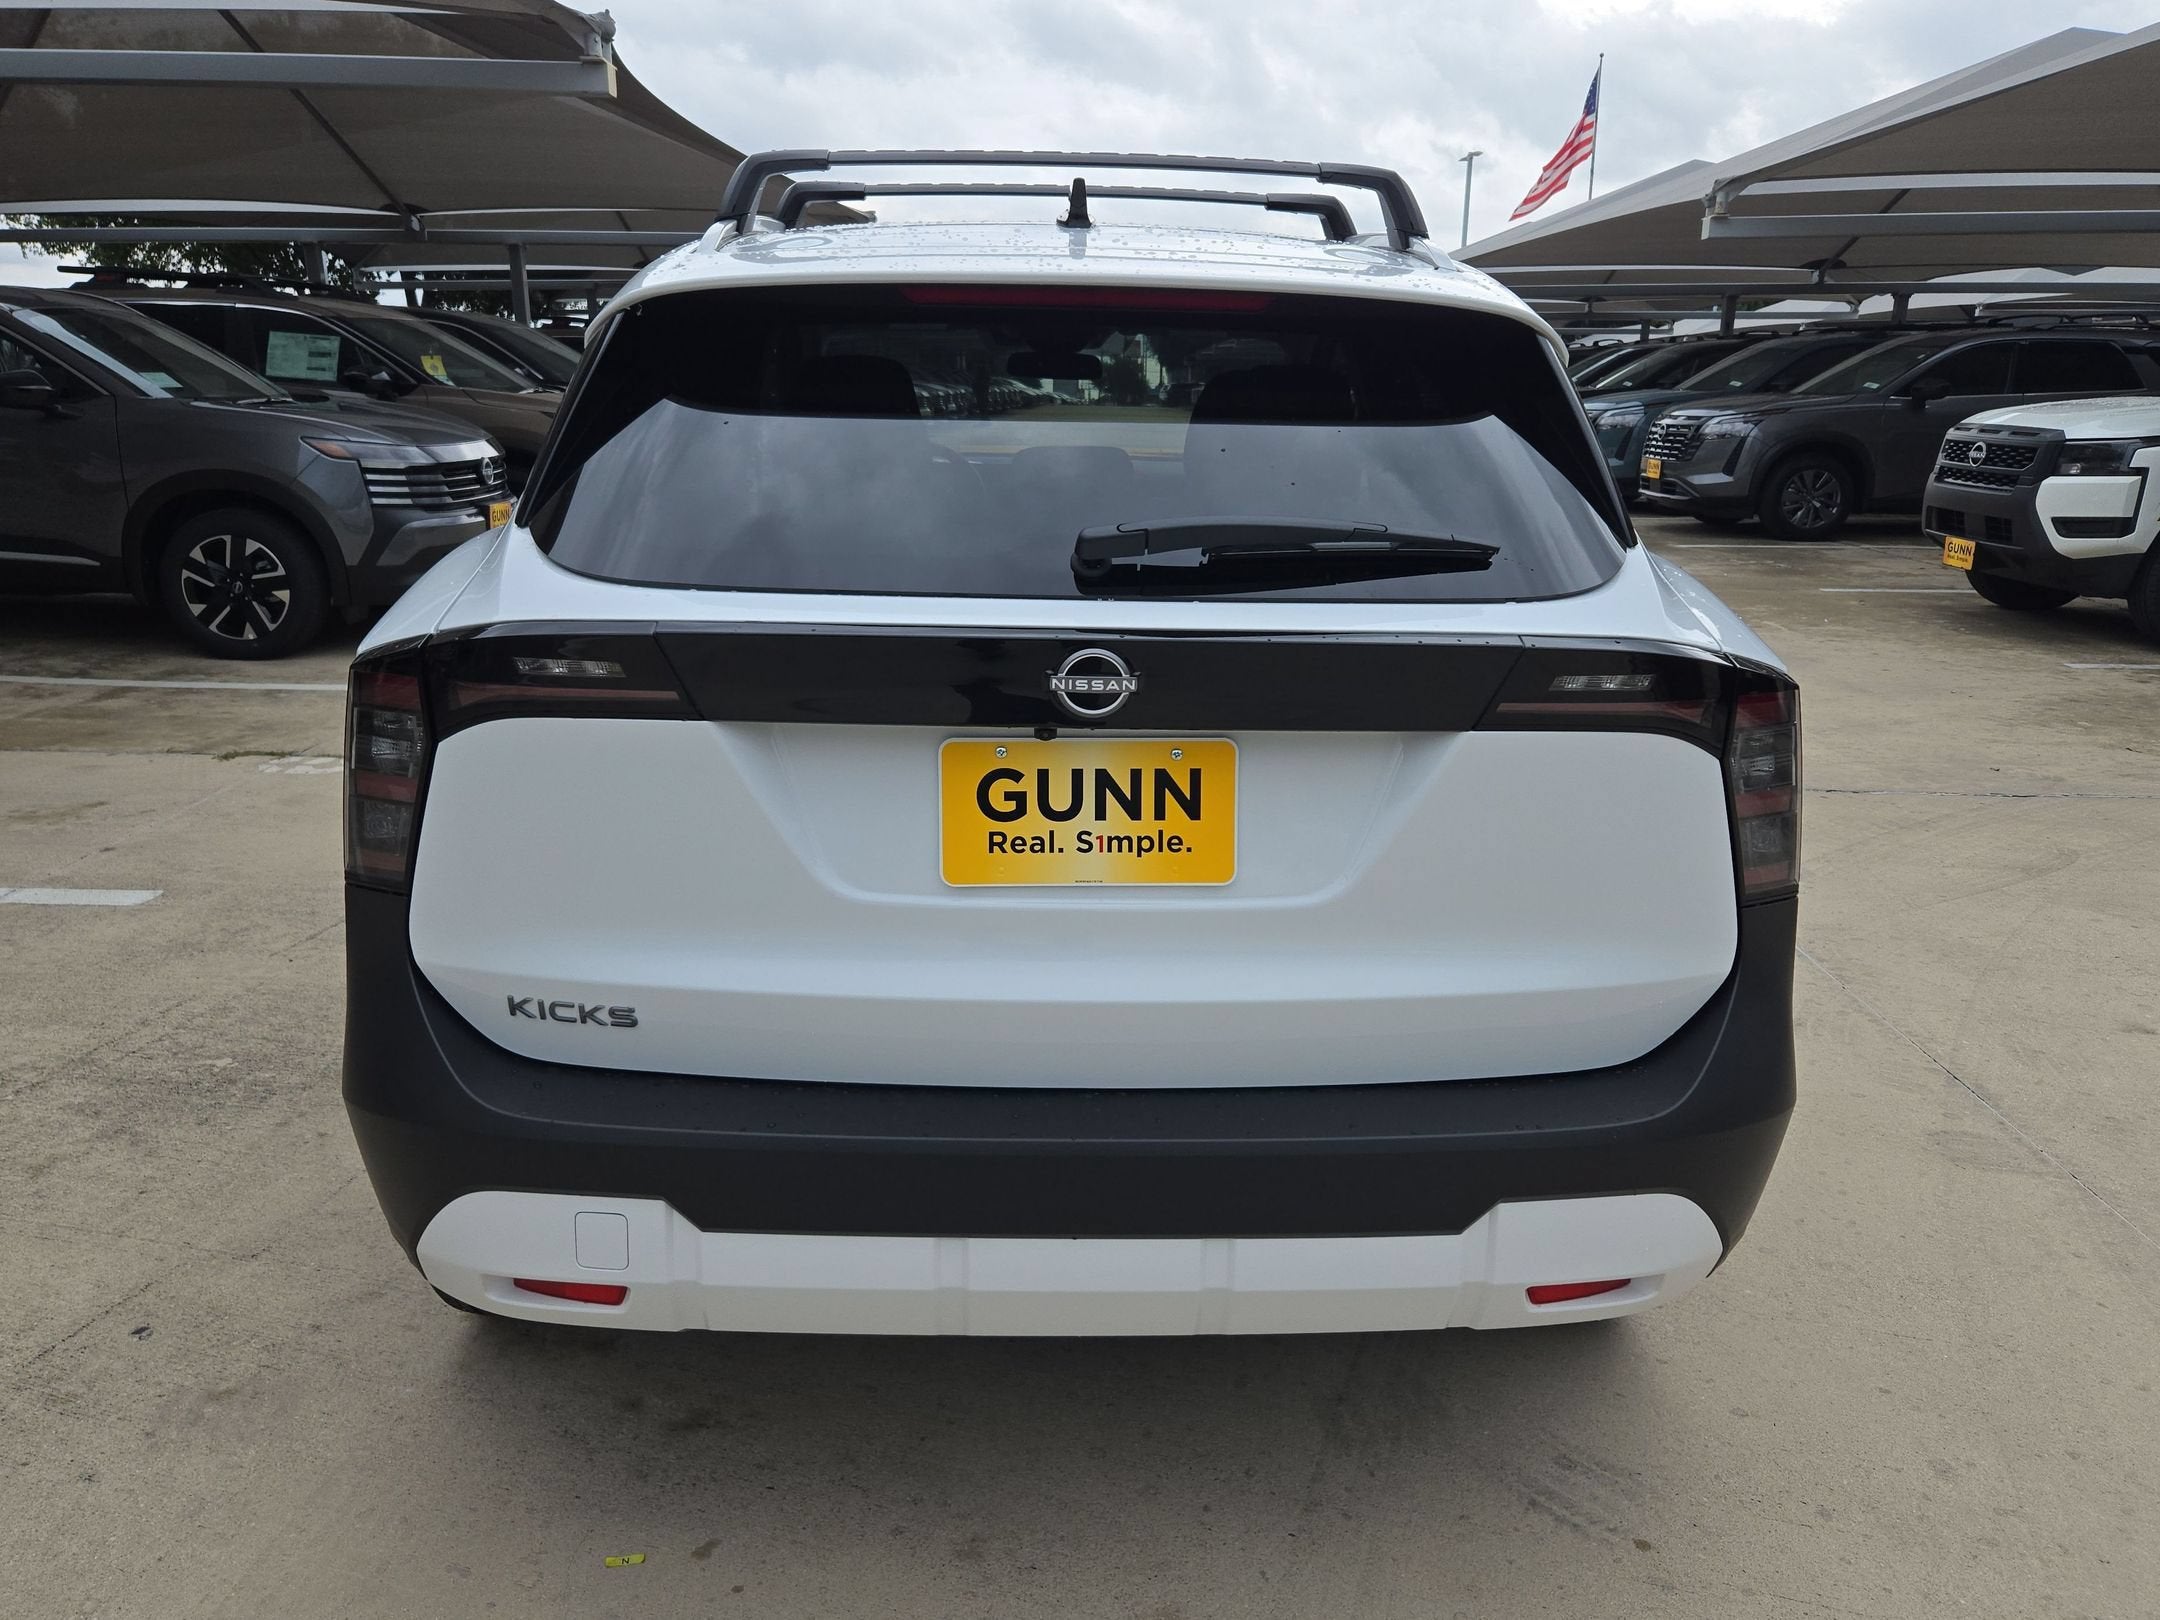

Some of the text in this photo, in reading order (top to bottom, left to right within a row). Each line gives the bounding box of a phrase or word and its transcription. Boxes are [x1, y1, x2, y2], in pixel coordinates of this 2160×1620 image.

[492, 508, 510, 522] GUNN
[1947, 541, 1973, 557] GUNN
[1051, 678, 1136, 691] NISSAN
[976, 767, 1202, 823] GUNN
[988, 830, 1064, 854] Real.
[507, 995, 639, 1028] KICKS
